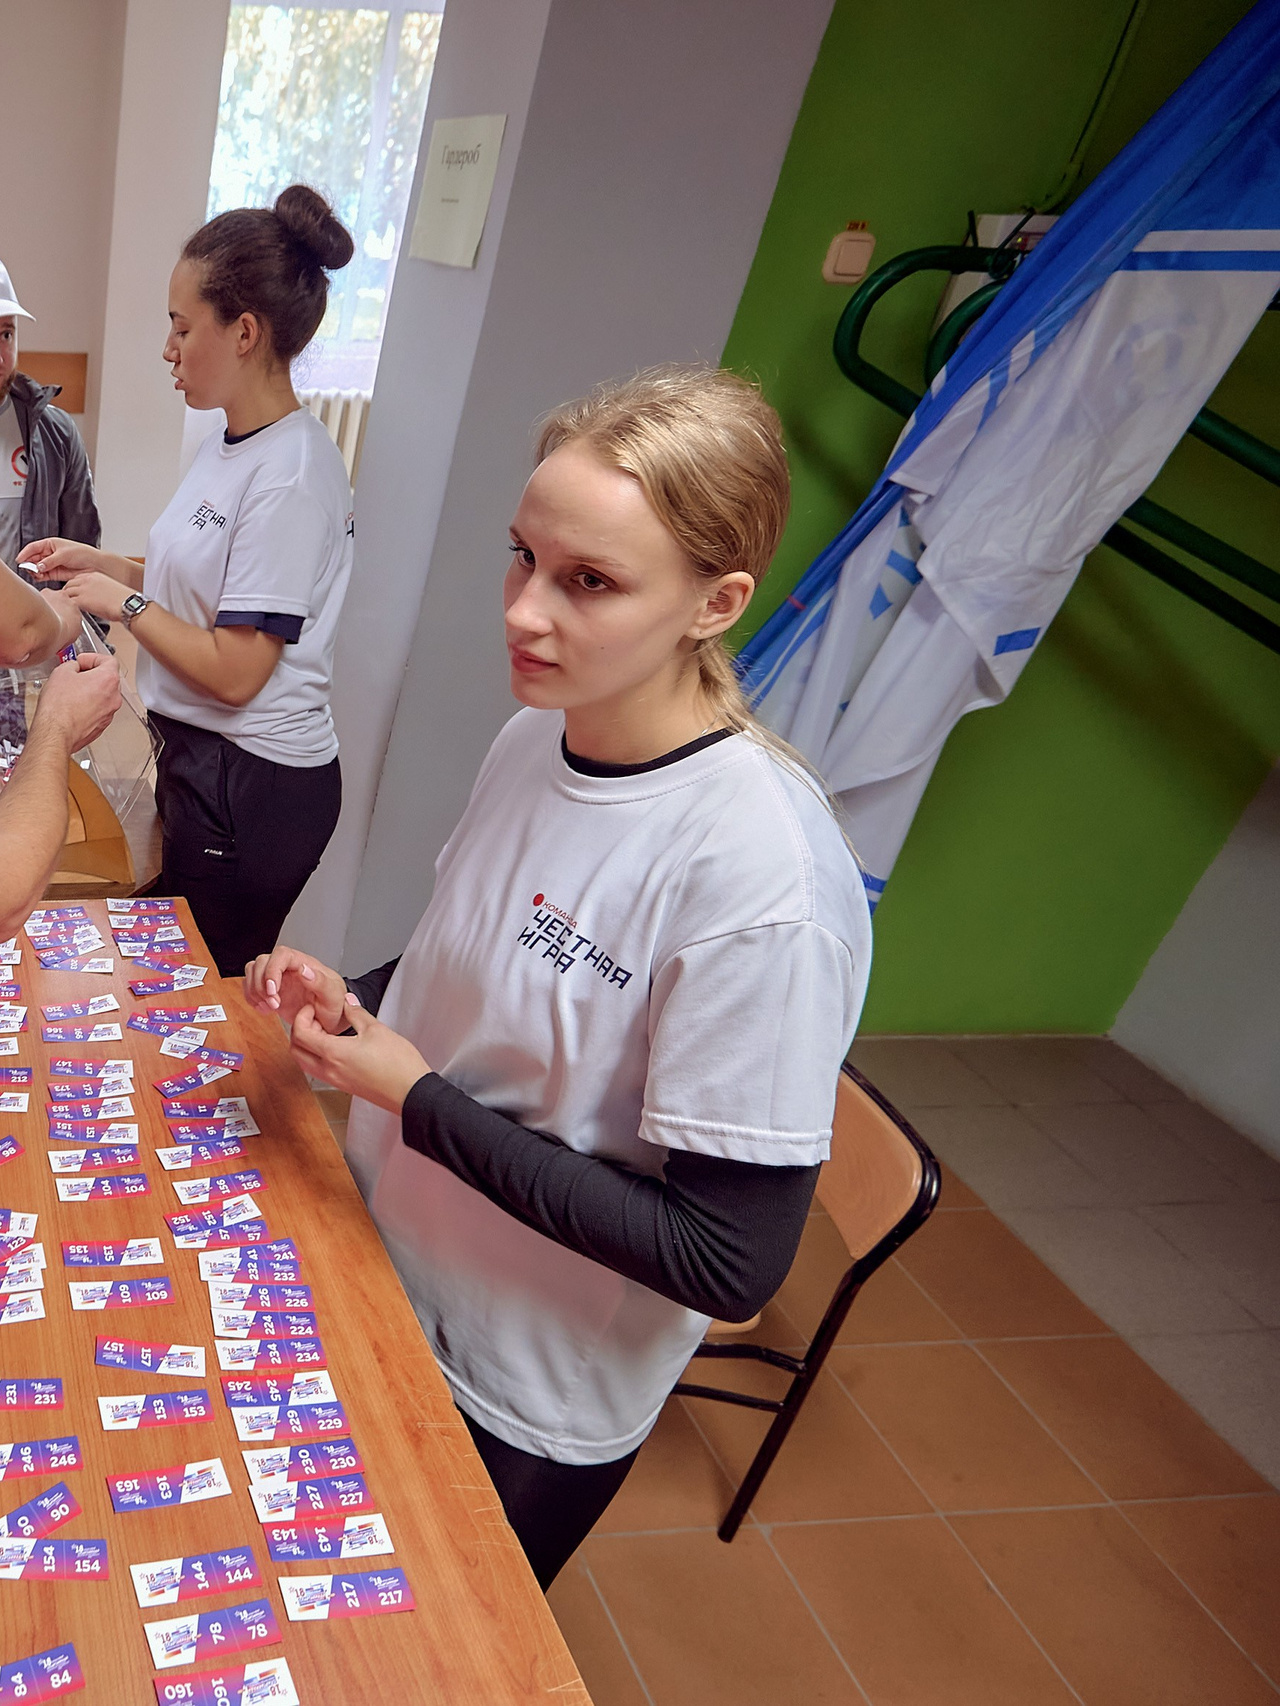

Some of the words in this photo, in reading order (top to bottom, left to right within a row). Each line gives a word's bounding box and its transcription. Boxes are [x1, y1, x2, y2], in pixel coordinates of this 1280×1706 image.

[542, 901, 578, 929] КОМАНДА
[516, 926, 576, 974] ИГРА
[532, 909, 633, 990] ЧЕСТНАЯ
[56, 1122, 72, 1130] 151
[206, 1126, 217, 1135] 16
[2, 1147, 16, 1157] 98
[116, 1155, 134, 1164] 114
[198, 1146, 212, 1160] 139
[222, 1147, 241, 1156] 139
[101, 1179, 112, 1196] 104
[124, 1185, 145, 1194] 104
[216, 1179, 230, 1194] 156
[241, 1182, 261, 1190] 156
[171, 1215, 191, 1225] 152
[202, 1210, 217, 1226] 152
[219, 1228, 230, 1240] 57
[248, 1233, 261, 1241] 57
[7, 1237, 27, 1251] 123
[69, 1245, 89, 1254] 135
[103, 1245, 115, 1262] 135
[247, 1262, 260, 1280] 232
[274, 1272, 296, 1281] 232
[119, 1284, 132, 1304] 109
[145, 1291, 168, 1301] 109
[258, 1288, 270, 1307] 226
[285, 1299, 309, 1307] 226
[262, 1315, 276, 1335] 224
[290, 1326, 313, 1335] 224
[103, 1341, 124, 1352] 157
[267, 1343, 282, 1364] 234
[141, 1347, 151, 1367] 157
[295, 1352, 320, 1362] 234
[228, 1381, 252, 1391] 245
[266, 1379, 282, 1402] 245
[5, 1384, 17, 1405] 231
[34, 1394, 57, 1404] 231
[153, 1399, 167, 1420] 153
[183, 1406, 206, 1418] 153
[287, 1410, 303, 1433] 229
[317, 1418, 342, 1430] 229
[20, 1446, 35, 1472] 246
[50, 1454, 77, 1467] 246
[298, 1449, 316, 1475] 230
[330, 1456, 356, 1470] 230
[116, 1479, 140, 1492] 163
[156, 1476, 172, 1500] 163
[305, 1485, 325, 1510] 227
[339, 1492, 363, 1506] 227
[50, 1504, 70, 1521] 90
[17, 1516, 35, 1536] 90
[272, 1529, 298, 1541] 143
[314, 1527, 332, 1553] 143
[43, 1545, 55, 1572] 154
[75, 1560, 101, 1573] 154
[191, 1561, 210, 1590] 144
[225, 1567, 253, 1583] 144
[341, 1581, 360, 1609] 217
[378, 1590, 402, 1606] 217
[209, 1622, 225, 1644] 78
[247, 1624, 268, 1640] 78
[11, 1672, 27, 1697] 84
[50, 1669, 72, 1688] 84
[164, 1683, 194, 1700] 160
